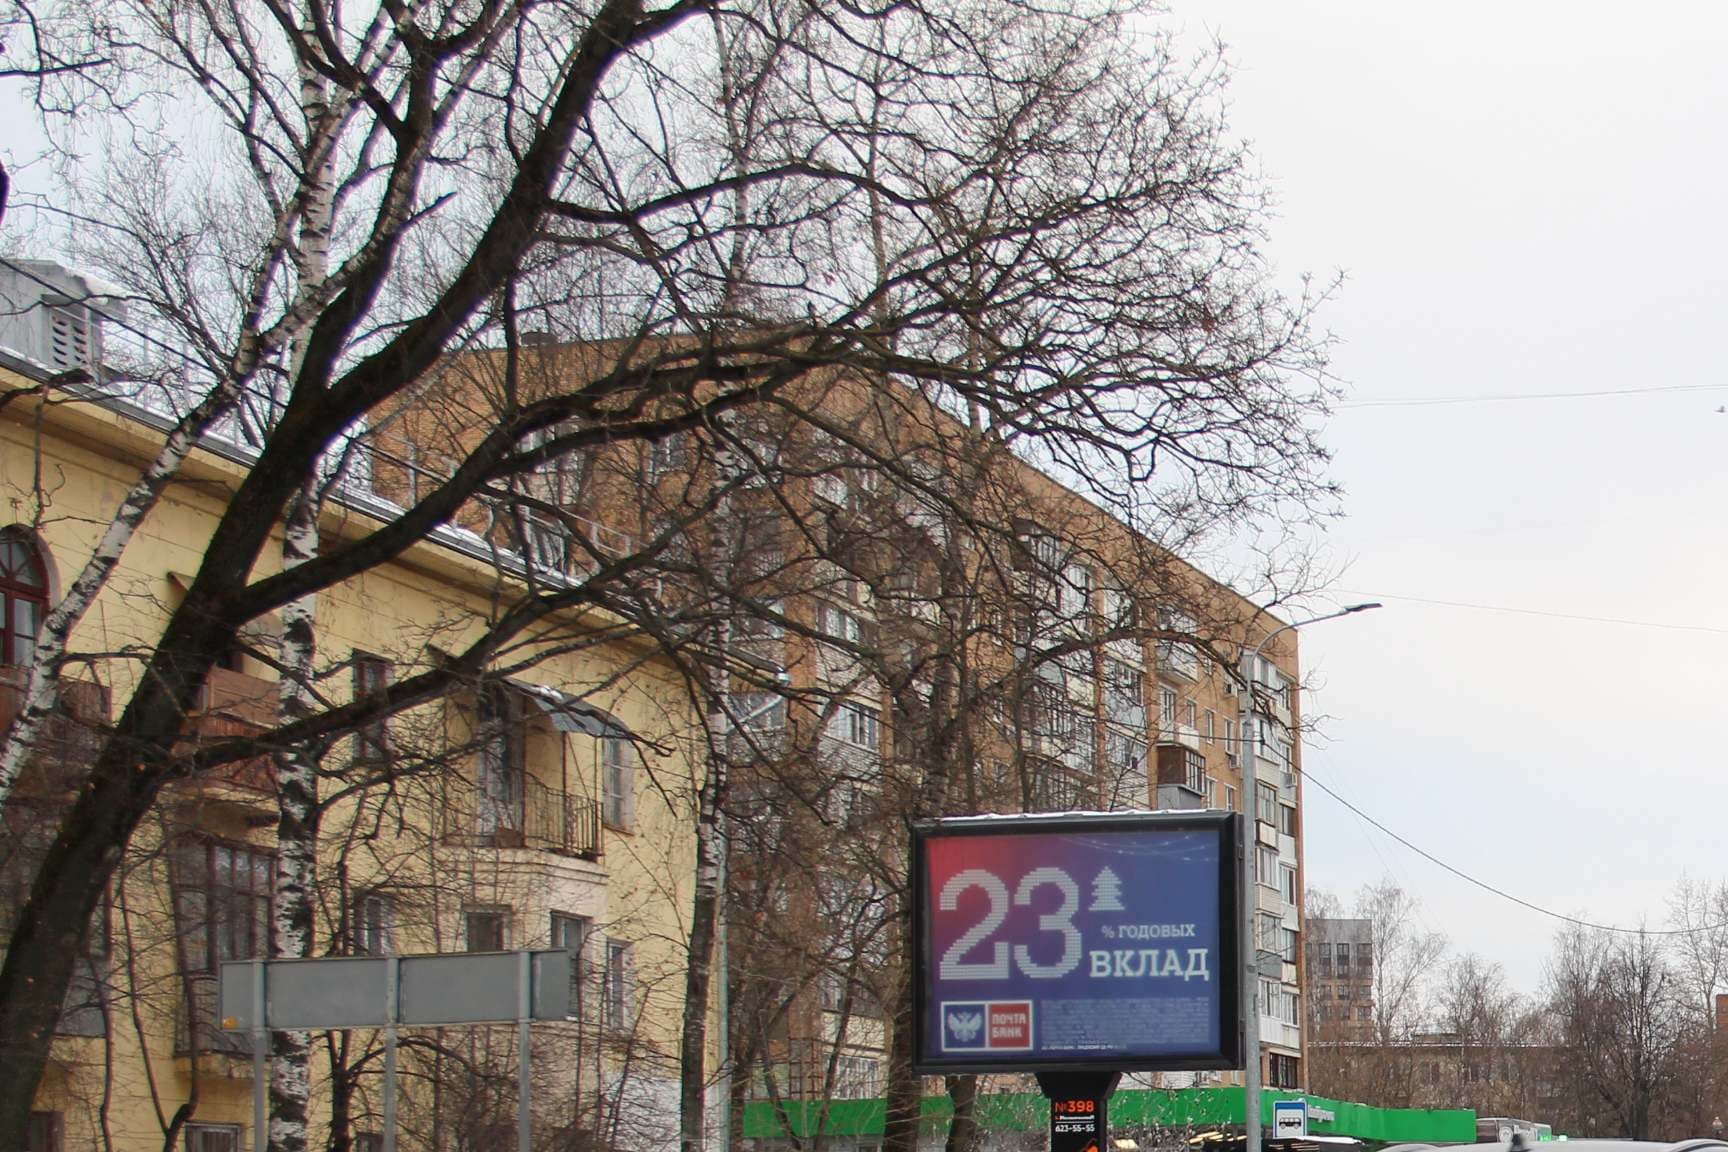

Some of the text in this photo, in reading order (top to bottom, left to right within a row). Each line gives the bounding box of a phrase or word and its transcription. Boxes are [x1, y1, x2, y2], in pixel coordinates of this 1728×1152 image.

[939, 866, 1082, 981] 23
[1102, 924, 1195, 940] % ГОДОВЫХ
[1088, 948, 1209, 981] ВКЛАД
[992, 1013, 1026, 1025] ПОЧТА
[992, 1027, 1022, 1038] БАНК
